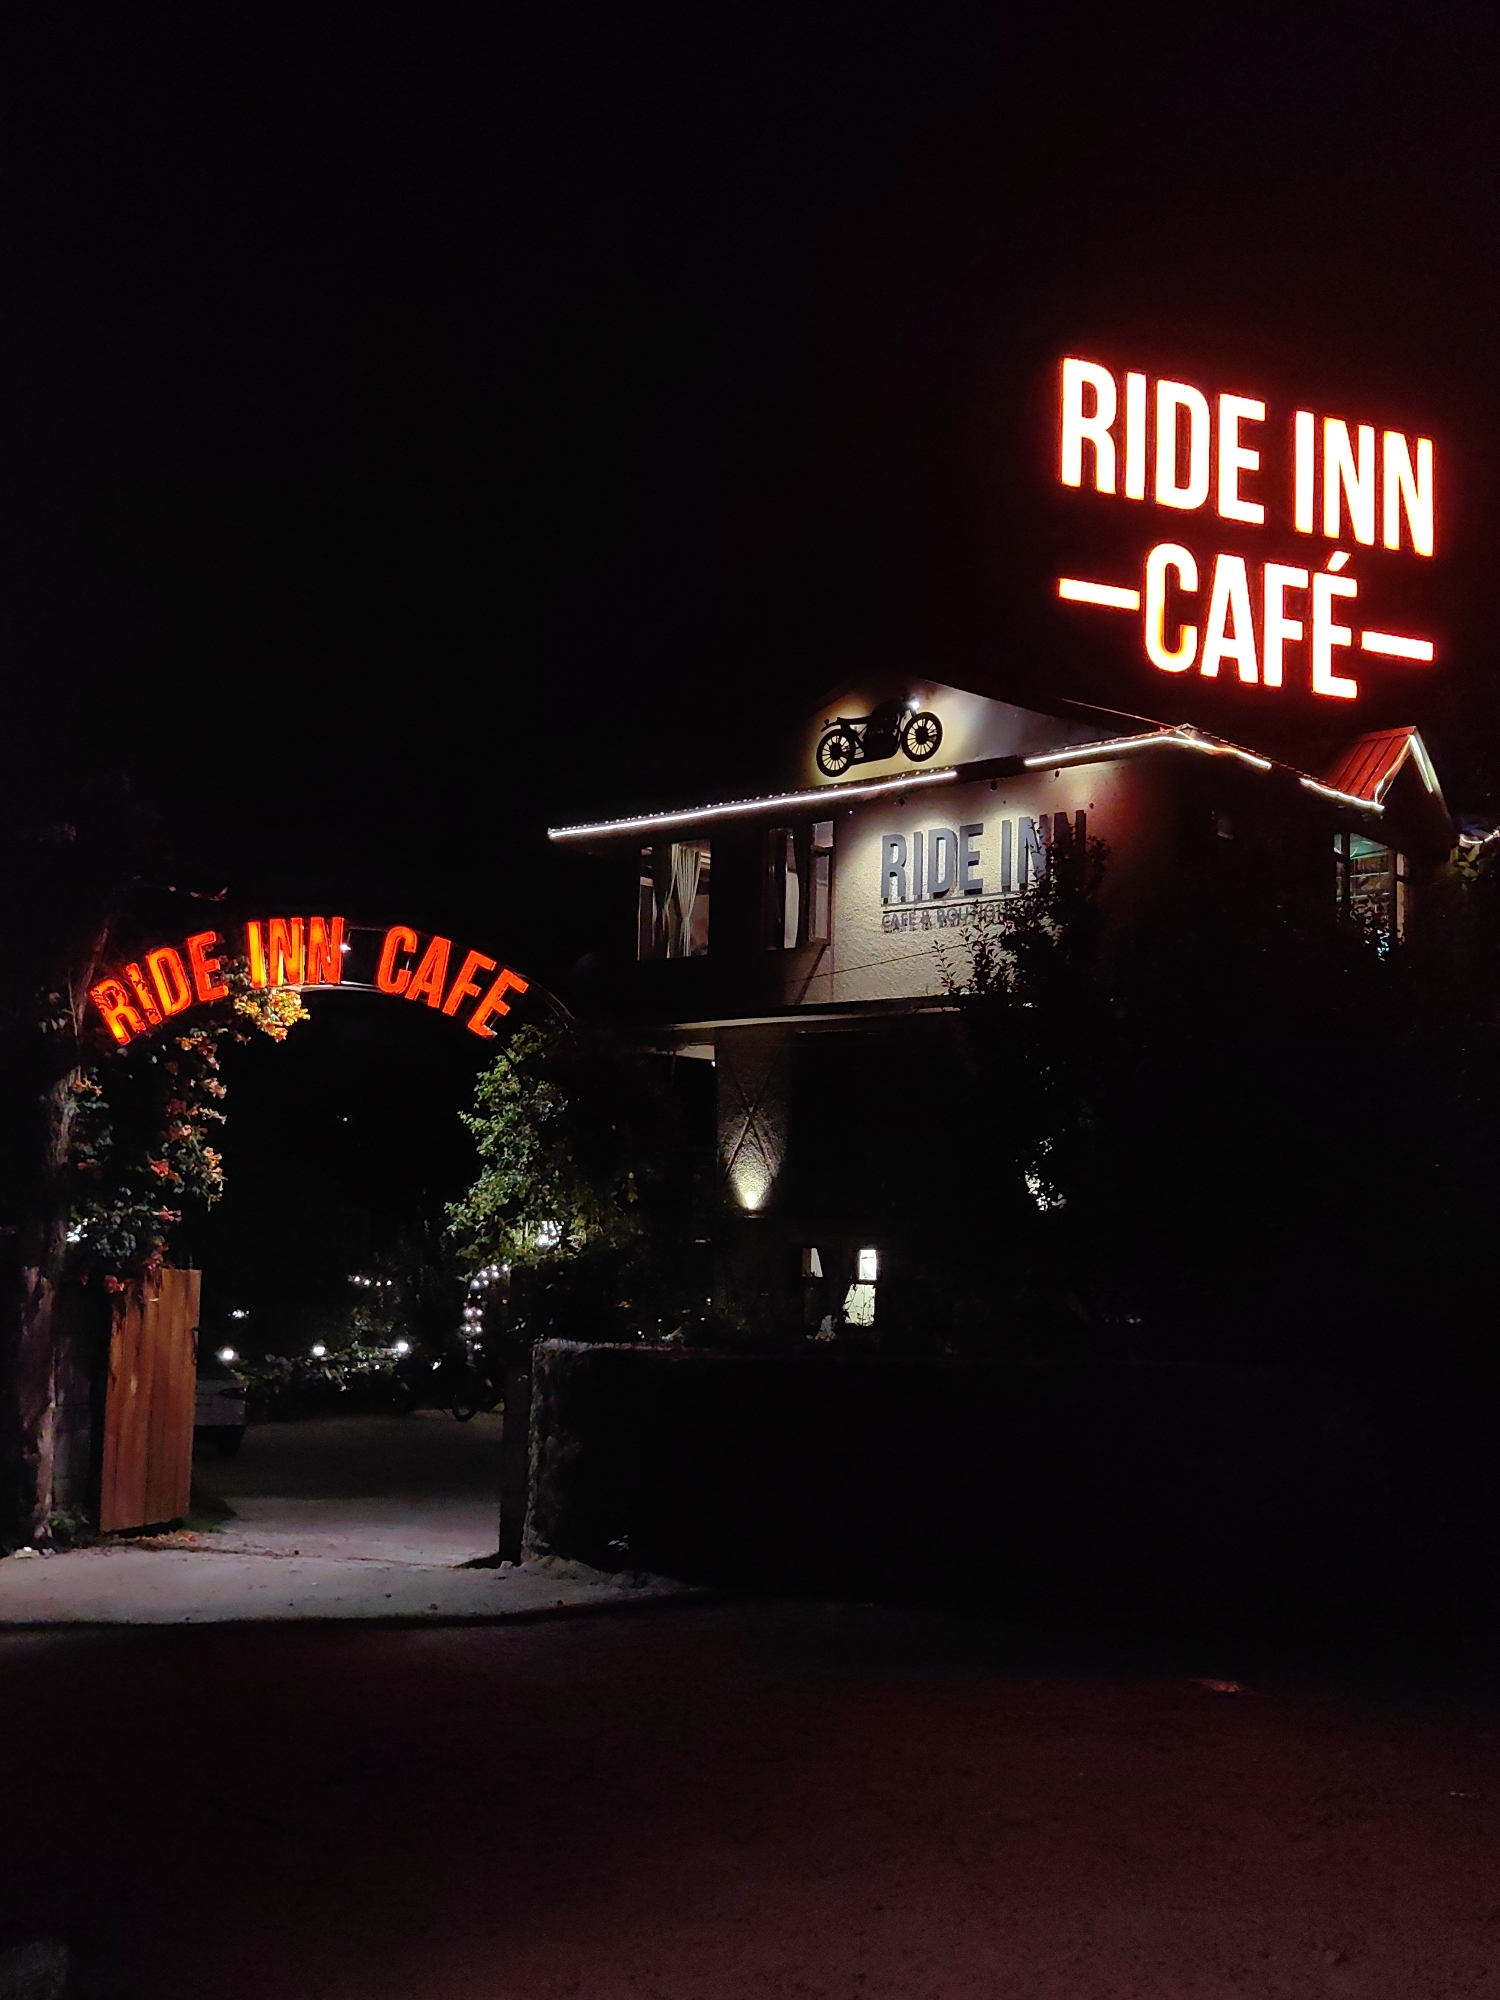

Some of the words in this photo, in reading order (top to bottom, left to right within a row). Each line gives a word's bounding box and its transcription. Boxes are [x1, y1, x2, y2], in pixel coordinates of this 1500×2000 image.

[1061, 357, 1266, 525] RIDE
[1294, 410, 1433, 557] INN
[881, 822, 984, 898] RIDE
[89, 931, 229, 1044] RIDE
[246, 917, 344, 988] INN
[376, 926, 529, 1037] CAFE
